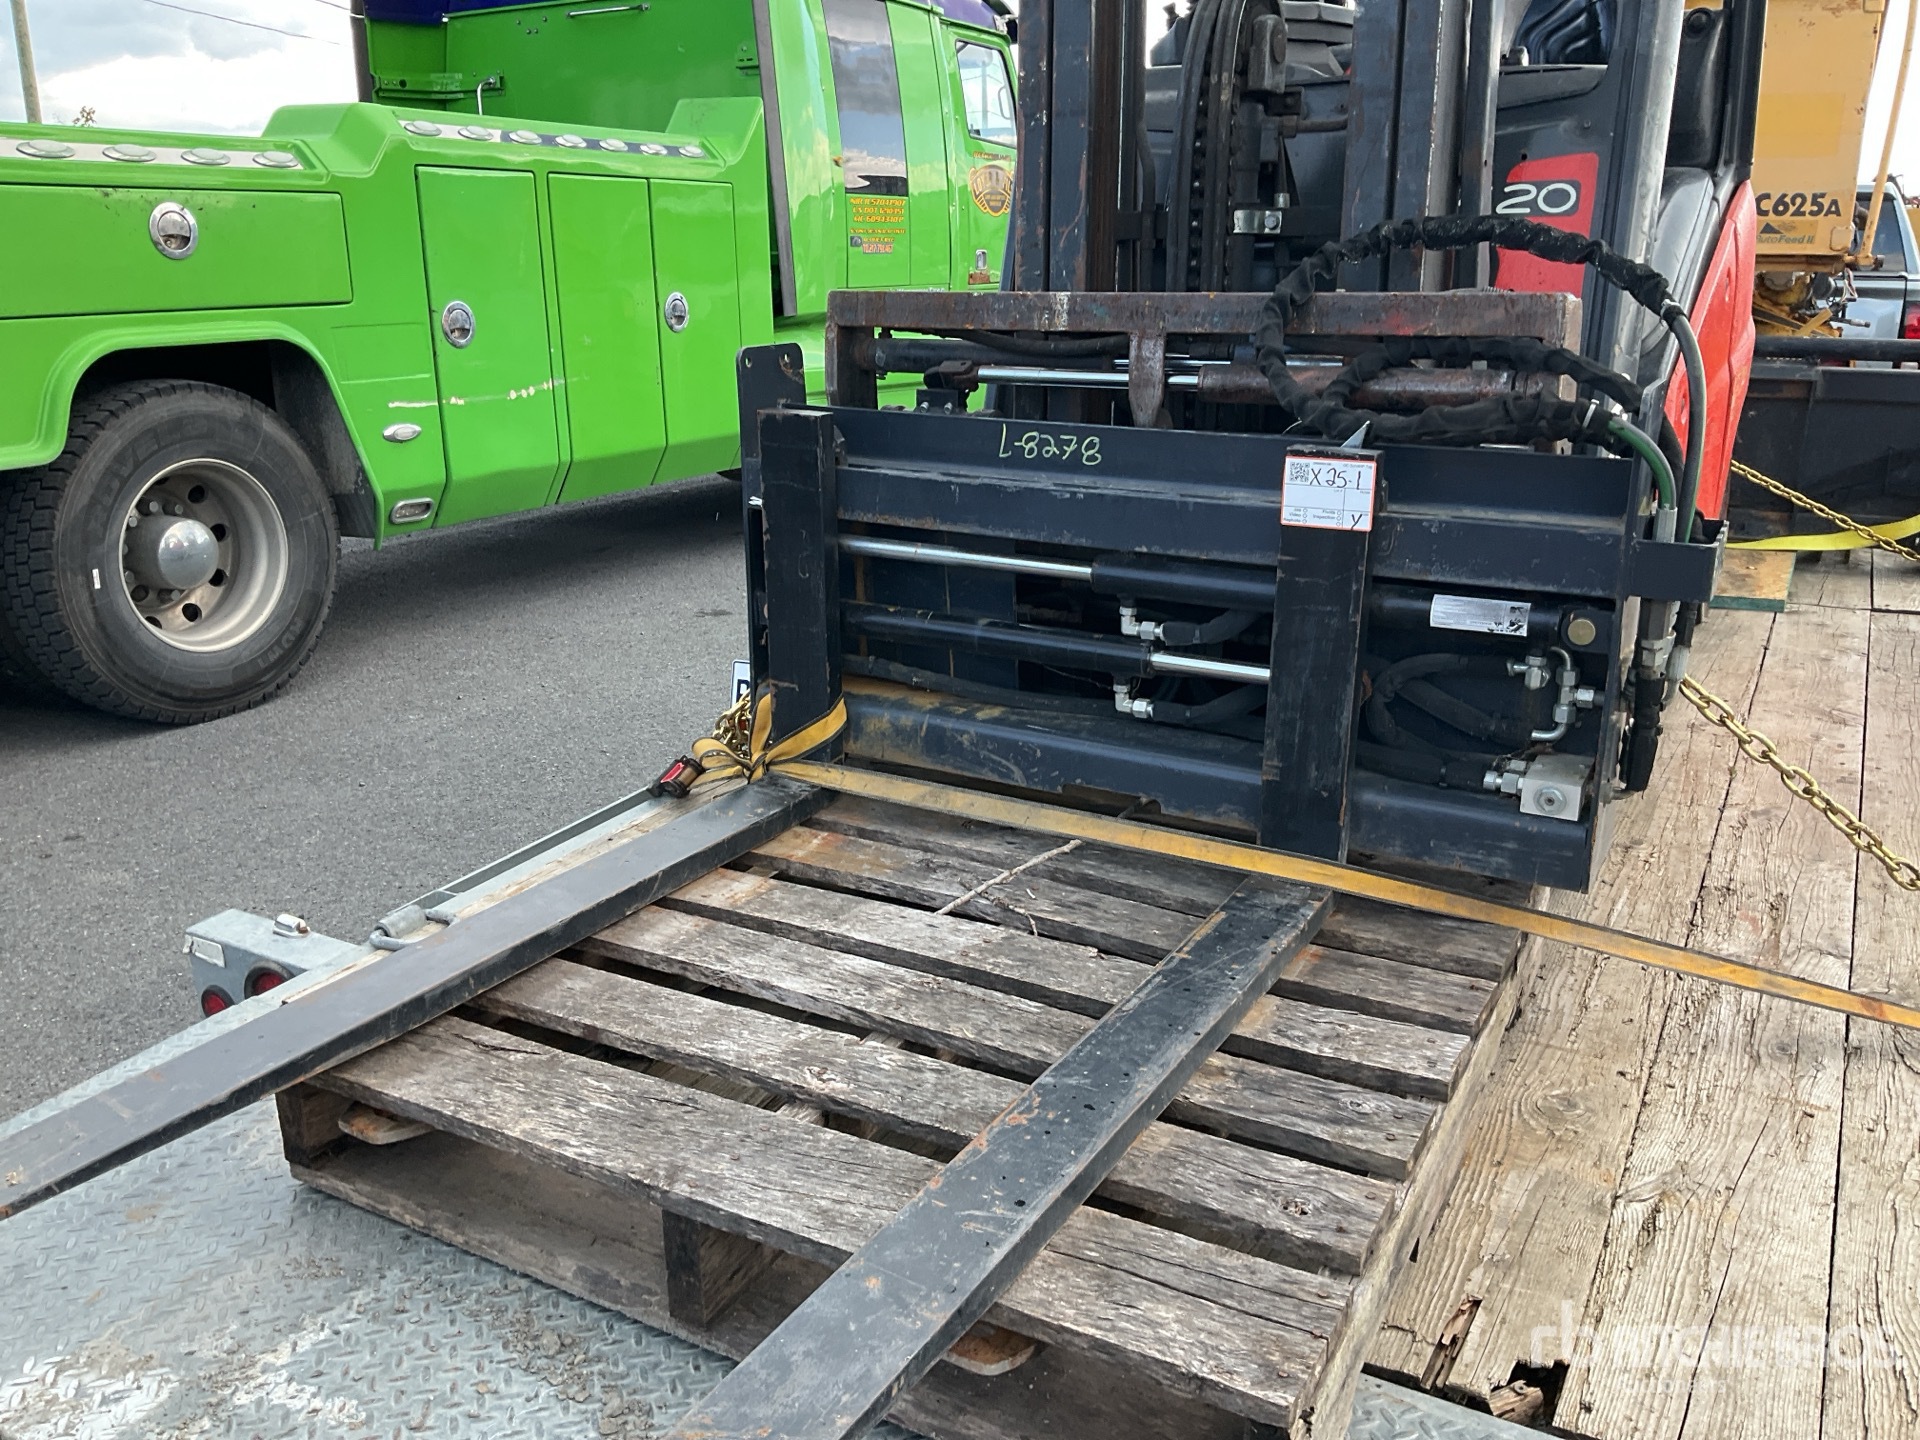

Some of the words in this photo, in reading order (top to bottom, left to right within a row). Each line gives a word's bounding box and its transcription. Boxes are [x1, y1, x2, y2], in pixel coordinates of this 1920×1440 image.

[1495, 182, 1577, 215] 20
[1755, 192, 1842, 217] C625A
[998, 422, 1103, 466] L-8278
